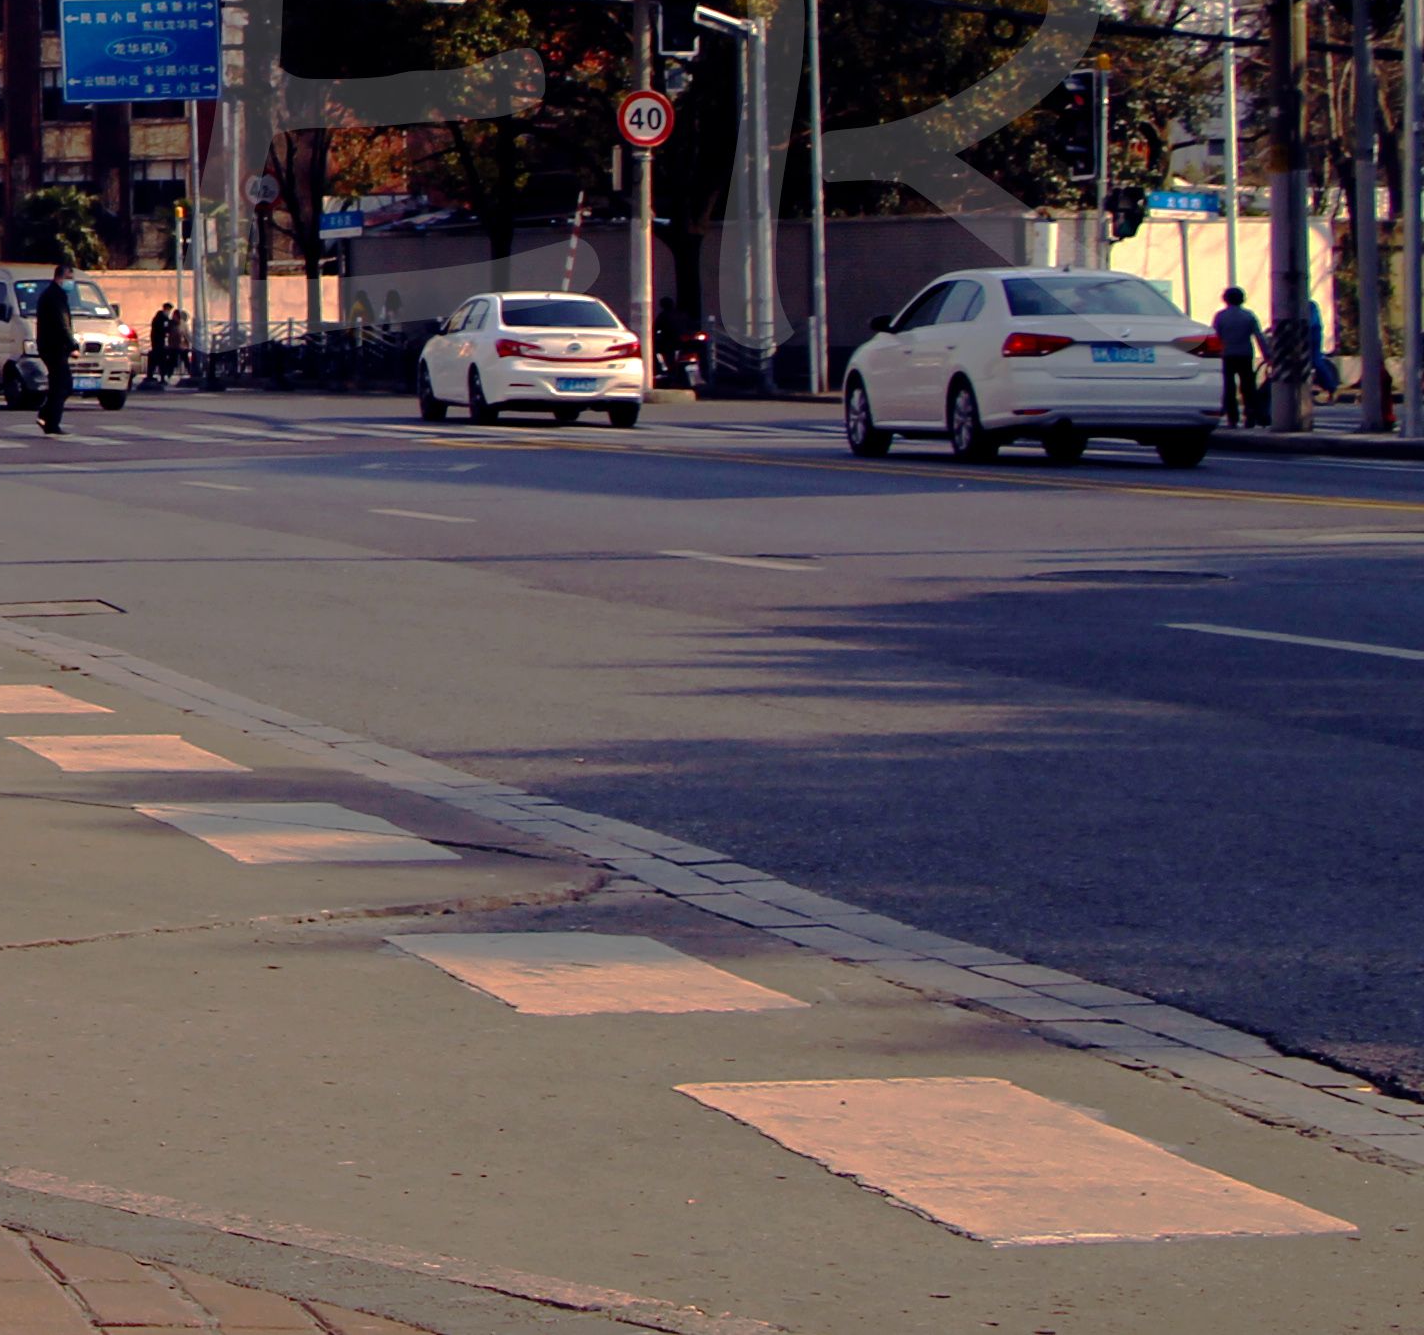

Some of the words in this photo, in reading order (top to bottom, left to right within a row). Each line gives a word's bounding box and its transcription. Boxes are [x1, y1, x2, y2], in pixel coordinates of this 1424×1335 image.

[113, 41, 169, 55] 龙华机场
[629, 107, 662, 130] 40
